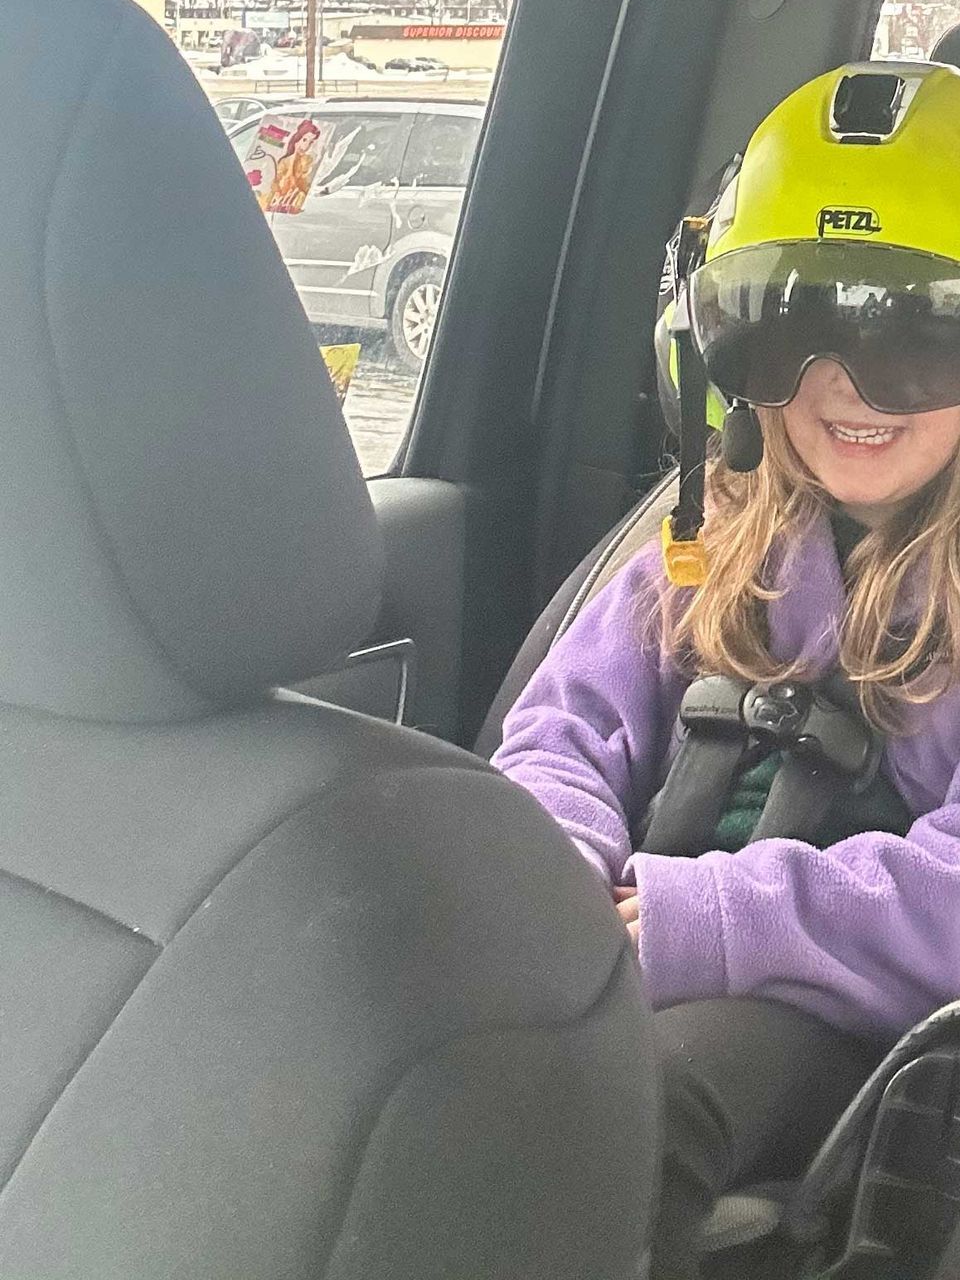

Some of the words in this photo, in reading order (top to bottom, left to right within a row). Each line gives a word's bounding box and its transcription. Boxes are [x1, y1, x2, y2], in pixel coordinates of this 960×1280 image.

[403, 26, 453, 38] SUPERIOR
[455, 26, 502, 38] DISCOUN
[818, 209, 882, 238] PETZL
